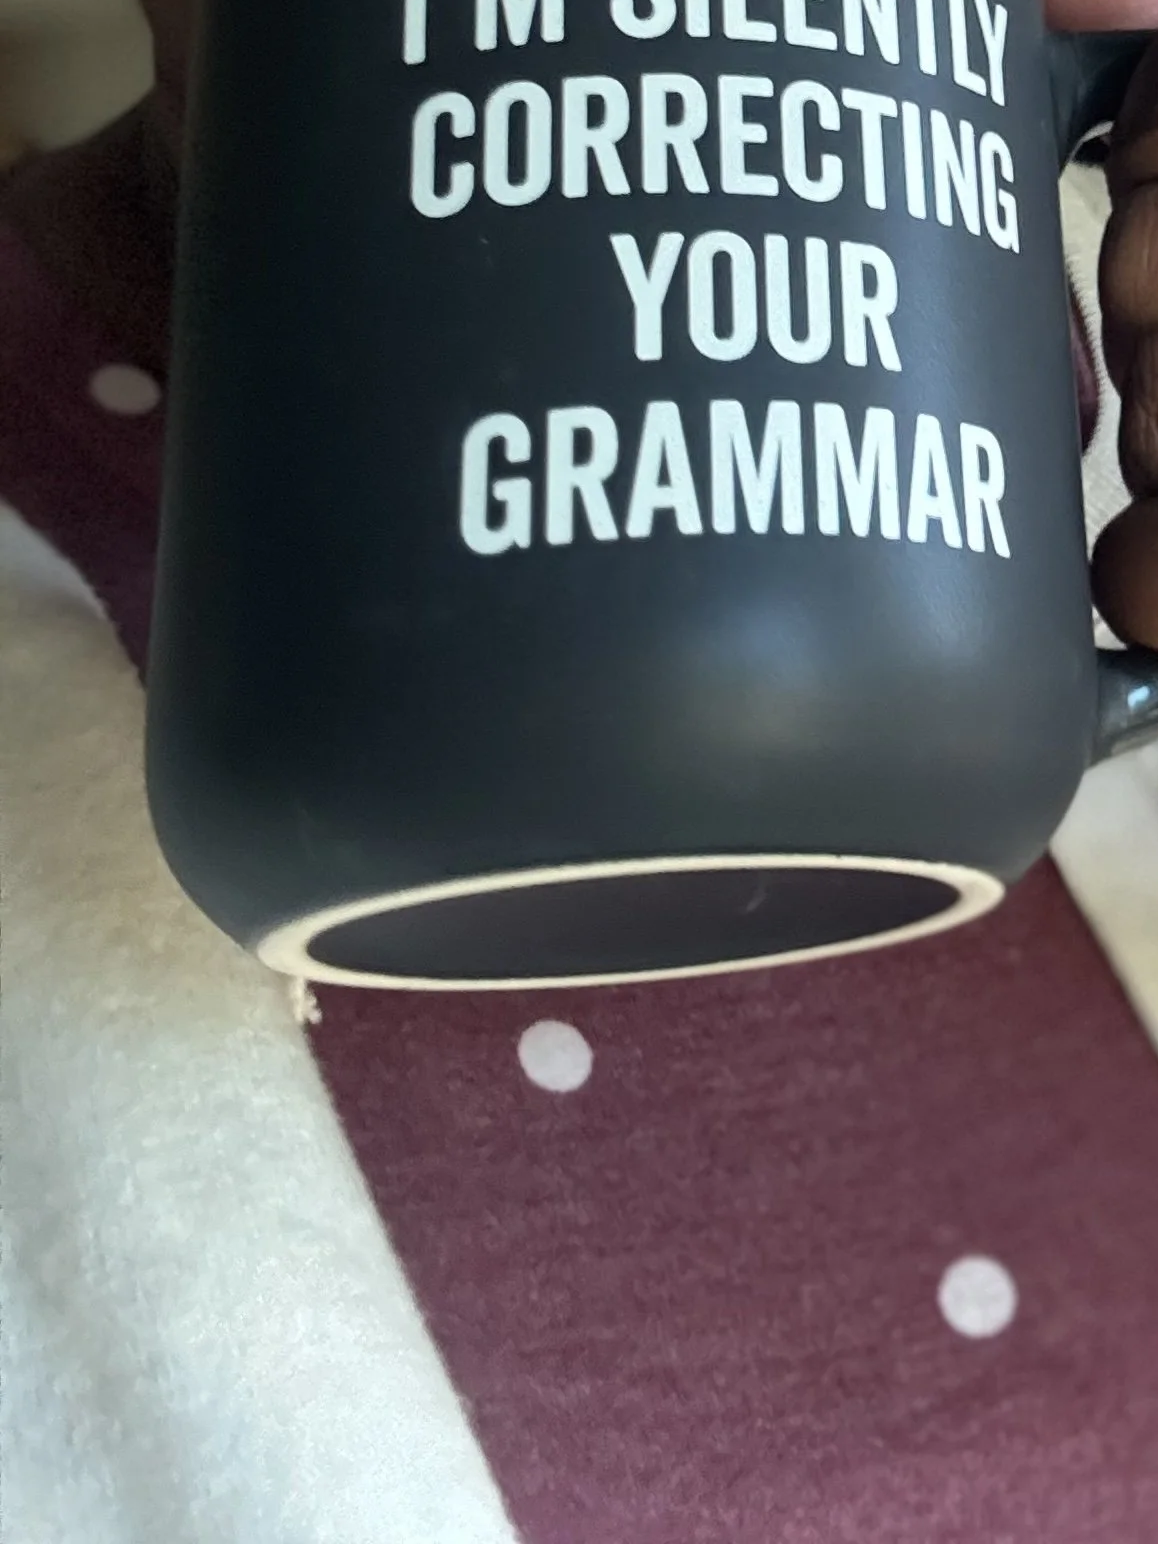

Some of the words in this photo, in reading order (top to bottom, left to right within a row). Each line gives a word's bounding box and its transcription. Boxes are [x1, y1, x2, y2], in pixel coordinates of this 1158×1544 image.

[411, 72, 1020, 254] CORRECTING
[609, 229, 903, 373] YOUR
[459, 398, 1012, 559] GRAMMAR
